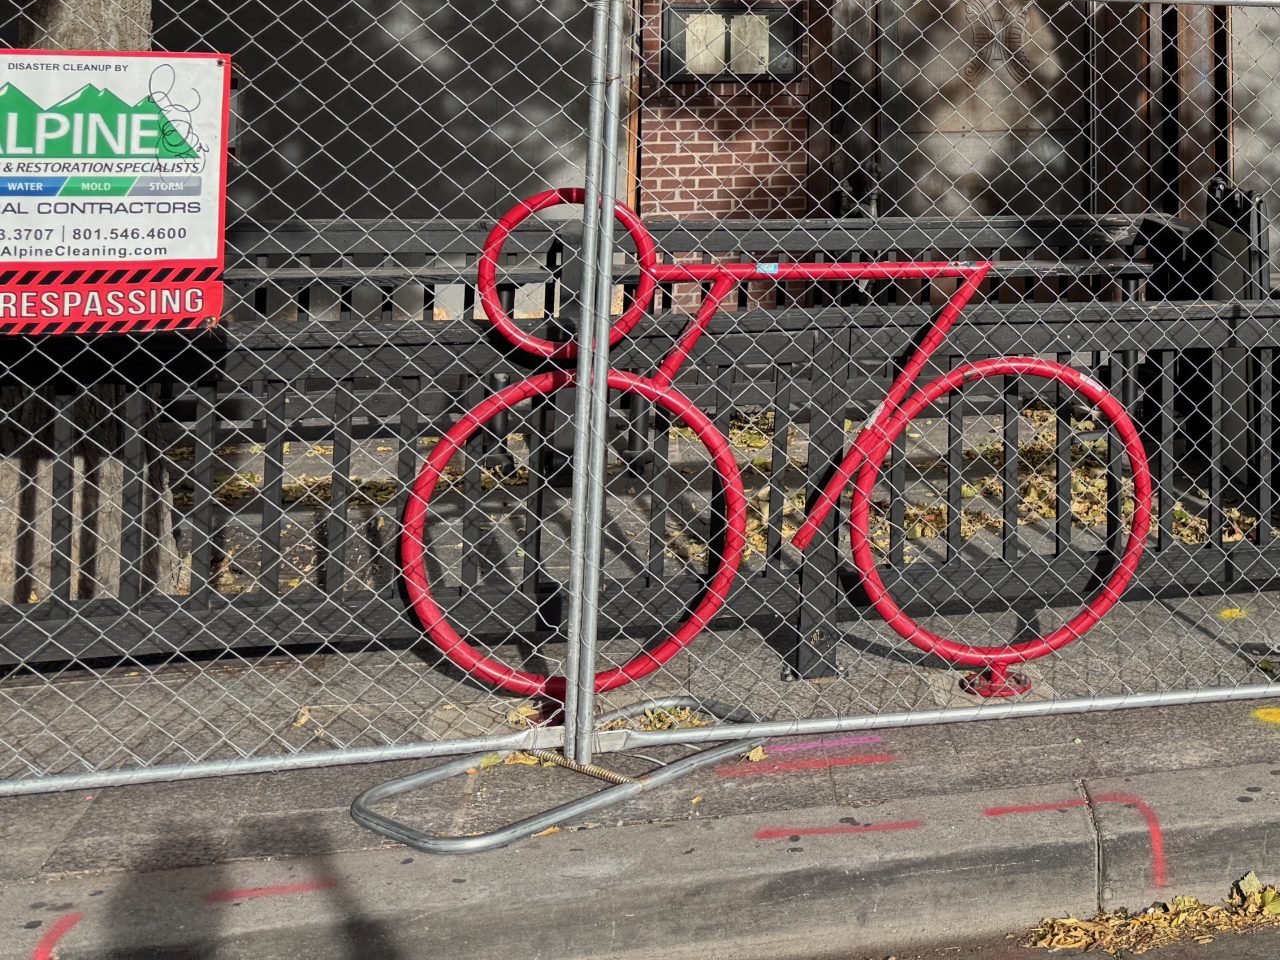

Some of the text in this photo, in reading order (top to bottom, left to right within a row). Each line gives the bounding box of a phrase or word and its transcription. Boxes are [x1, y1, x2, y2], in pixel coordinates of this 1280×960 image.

[8, 62, 129, 72] DISASTER CLEANUP BY
[0, 112, 160, 155] LPINE
[3, 162, 201, 173] & RESTORATION SPECIALISTS
[7, 182, 43, 191] WATER
[81, 182, 111, 191] MOLD
[149, 182, 184, 191] STORM
[1, 202, 201, 214] AL CONTRACTORS
[72, 227, 187, 241] 801.546.4600
[1, 245, 167, 259] AlpineCleaning.com
[0, 288, 204, 318] RESPASSING
